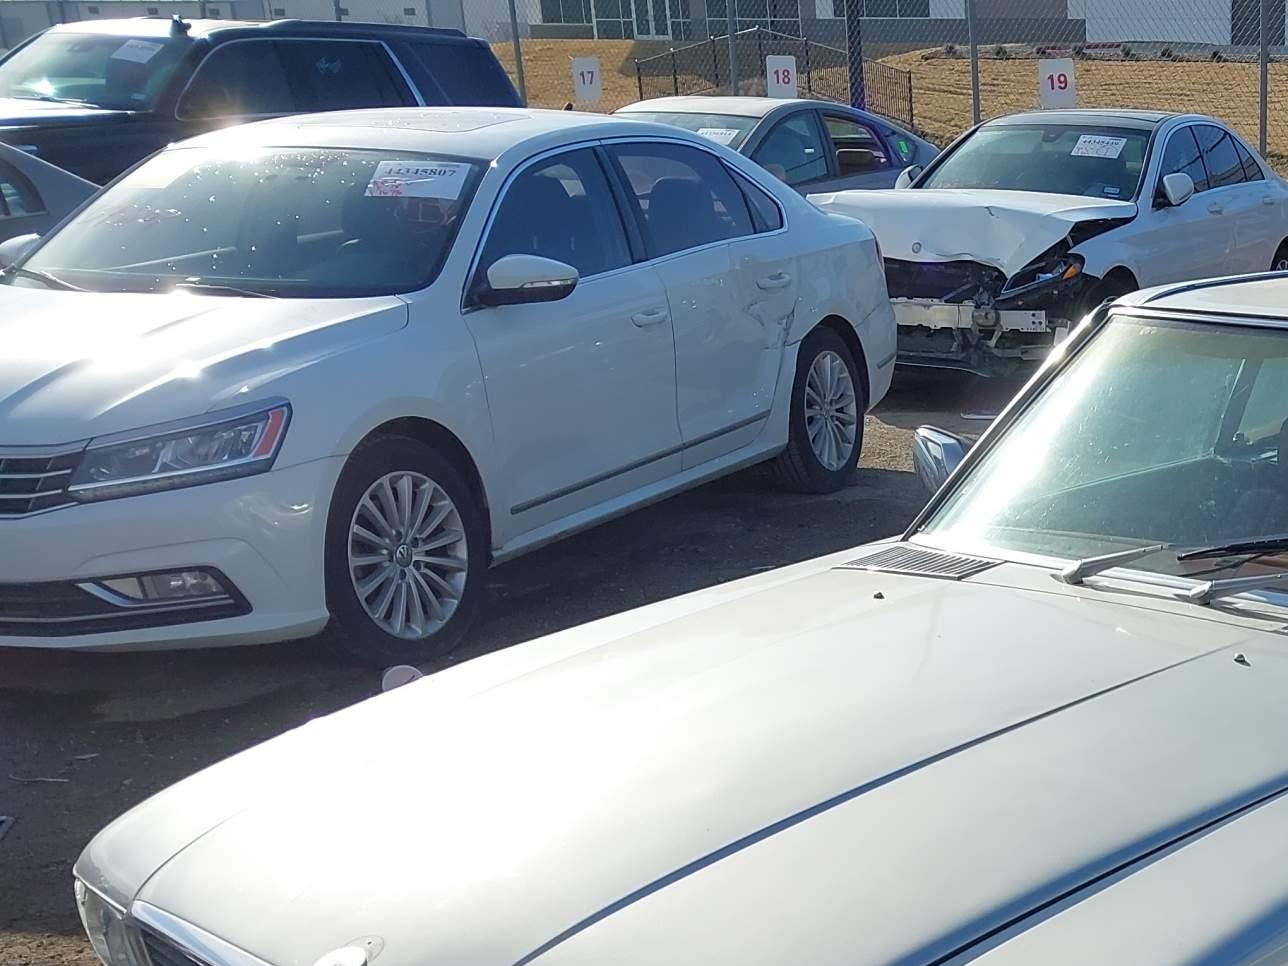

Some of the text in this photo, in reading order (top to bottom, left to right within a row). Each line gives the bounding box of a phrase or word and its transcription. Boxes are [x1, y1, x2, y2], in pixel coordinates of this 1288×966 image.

[579, 70, 594, 86] 17
[774, 69, 790, 85] 18
[1047, 73, 1068, 91] 19
